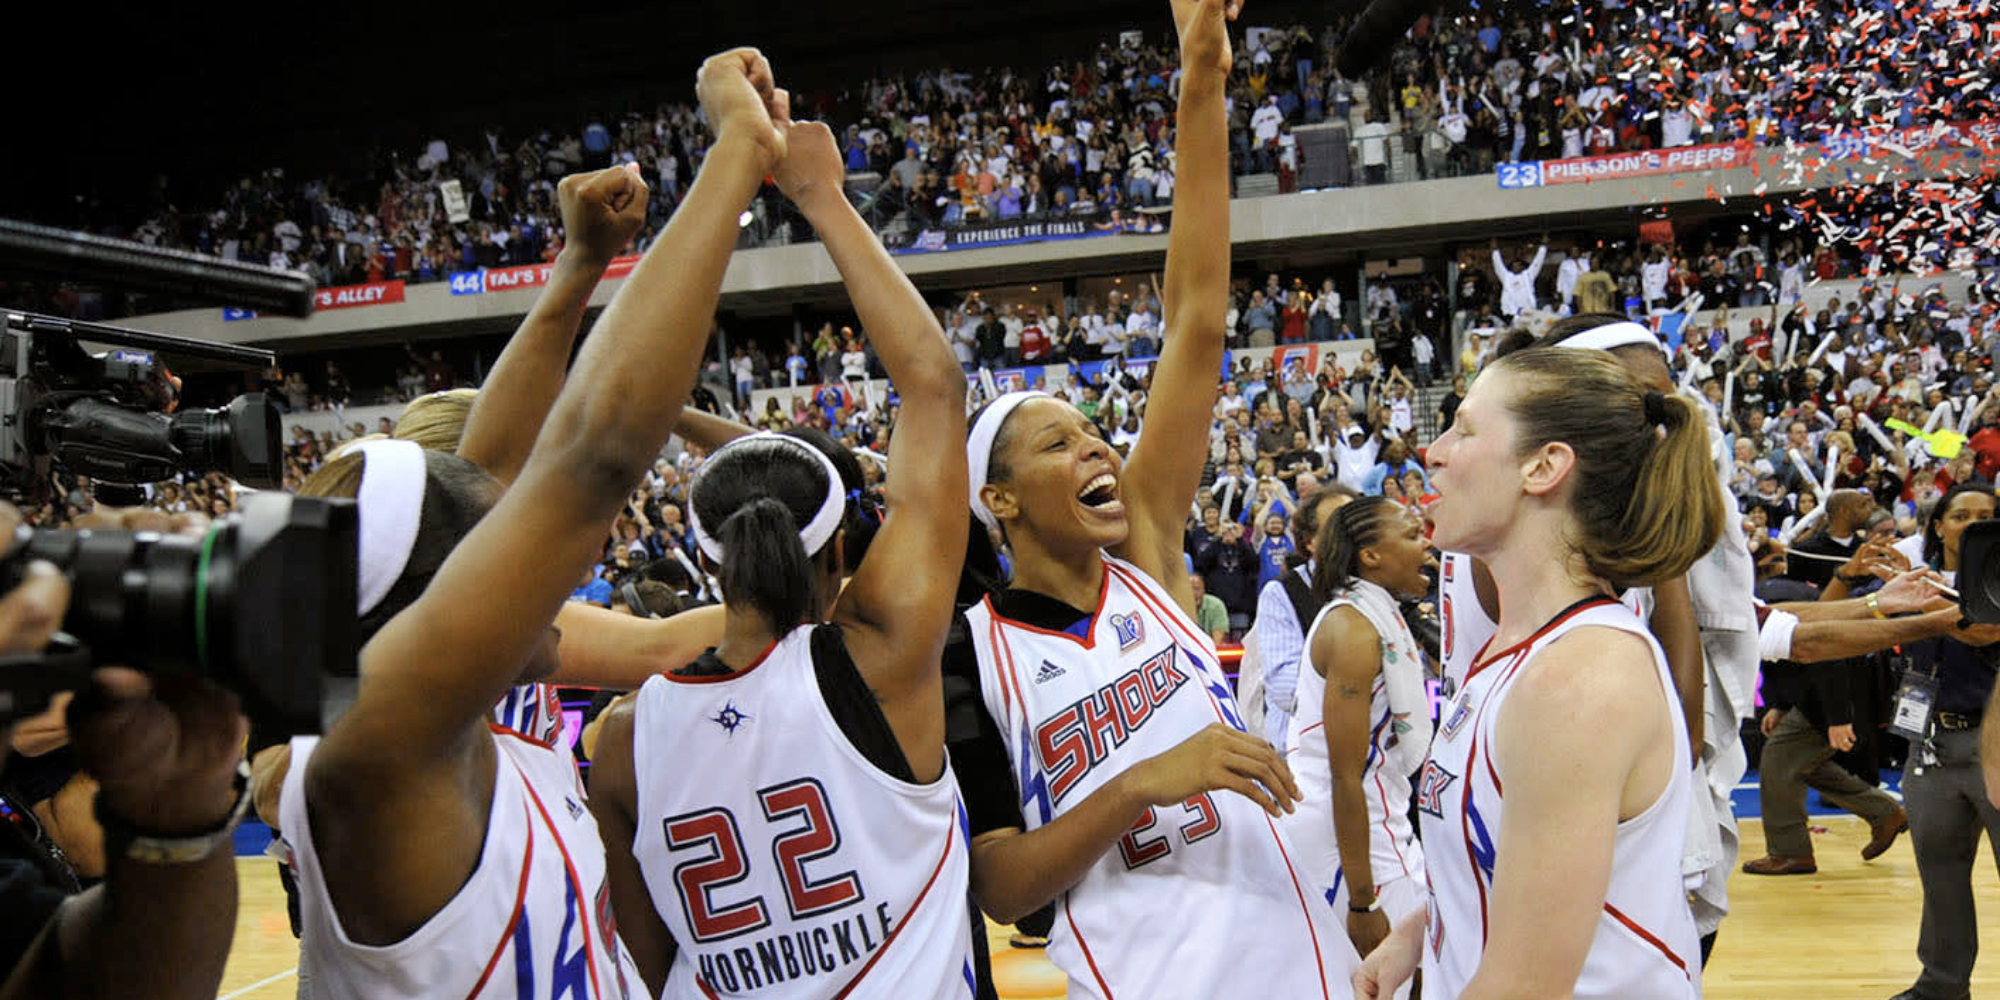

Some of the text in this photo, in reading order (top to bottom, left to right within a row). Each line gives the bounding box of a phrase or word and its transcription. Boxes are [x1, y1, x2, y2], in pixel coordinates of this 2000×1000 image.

[1502, 146, 1736, 187] 23 PIERSON'S PEEPS
[956, 228, 1020, 244] EXPERIENCE
[1023, 224, 1043, 237] THE
[1047, 221, 1086, 235] FINALS
[336, 285, 387, 303] ALLEY
[452, 274, 480, 292] 44
[489, 270, 534, 287] TAJ'S
[1033, 641, 1191, 809] SHOCK
[662, 776, 866, 945] 22
[698, 901, 895, 994] HORNBUCKLE
